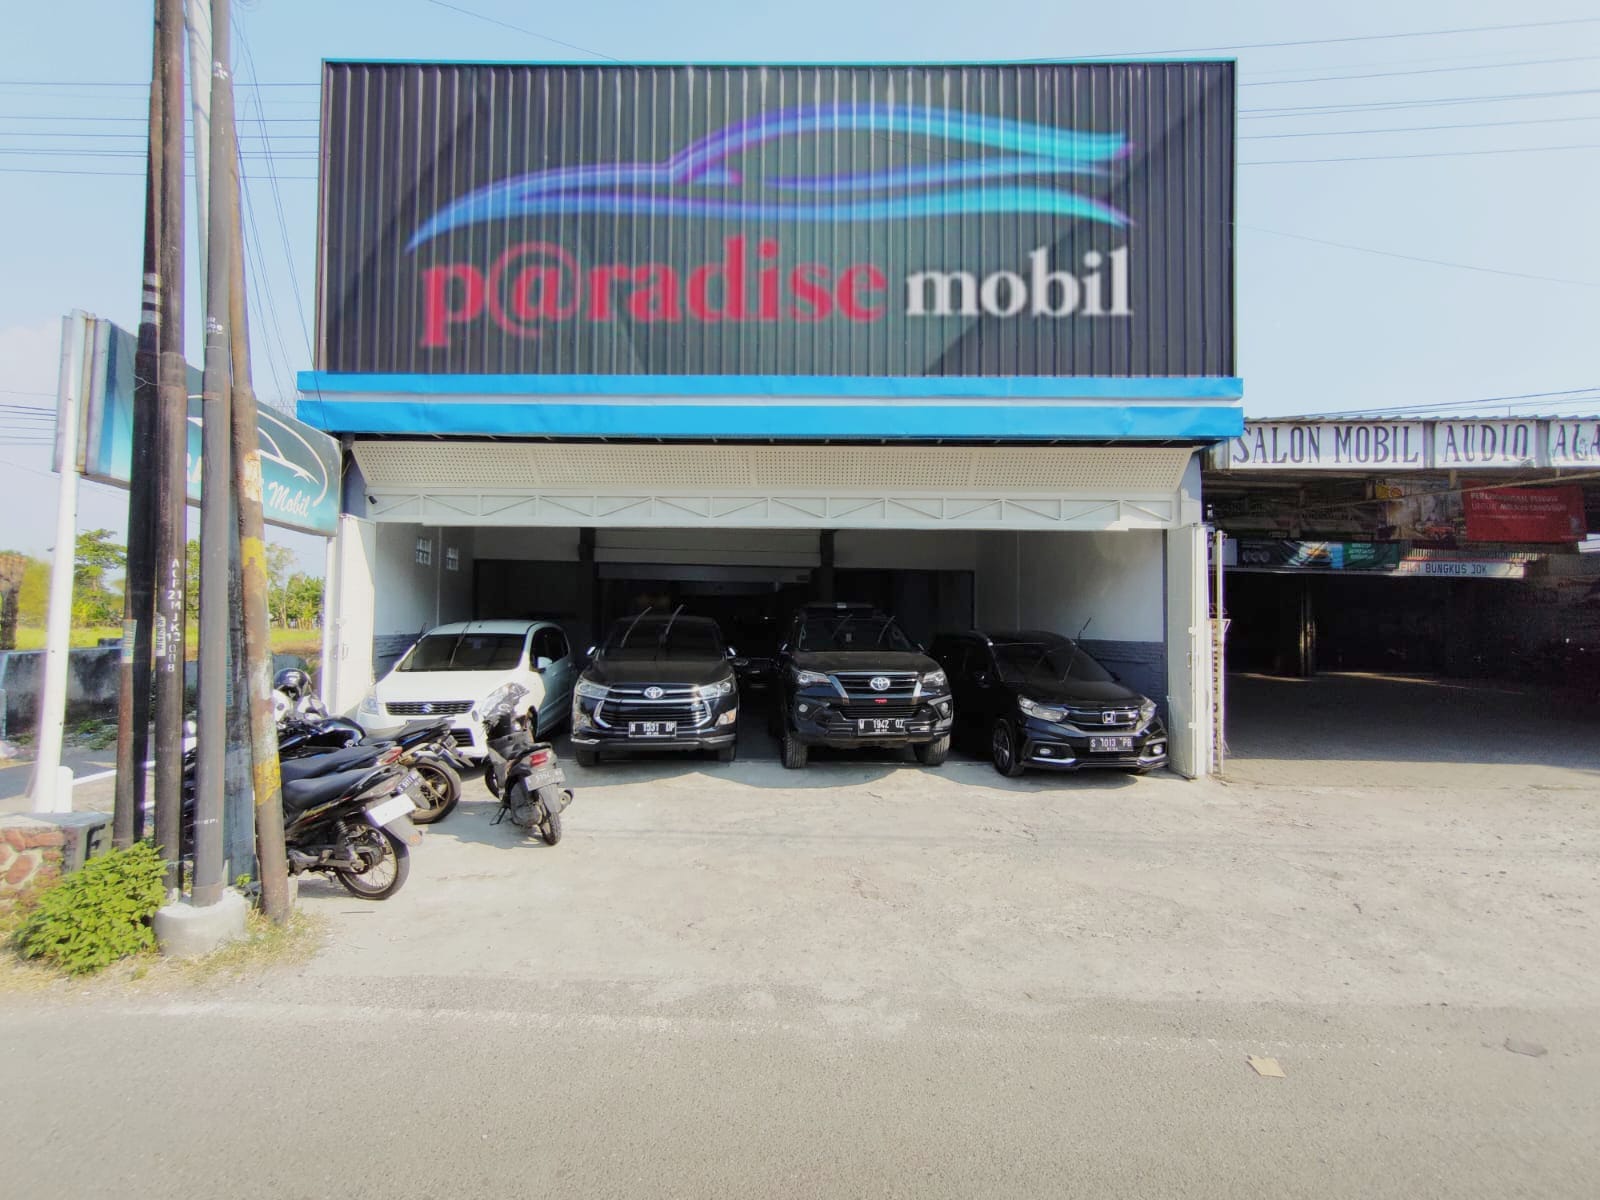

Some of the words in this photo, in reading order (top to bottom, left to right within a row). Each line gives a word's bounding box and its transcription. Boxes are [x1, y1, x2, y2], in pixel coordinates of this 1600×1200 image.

[420, 235, 887, 348] p@radise
[906, 246, 1133, 317] mobil
[1232, 426, 1321, 464] SALON
[1334, 426, 1419, 464] MOBIL
[1444, 424, 1529, 462] AUDIO
[268, 481, 311, 518] Mobil
[1425, 563, 1467, 574] BUNGKUS
[1471, 563, 1488, 574] JOK
[873, 719, 890, 729] 1942
[1090, 739, 1096, 748] S
